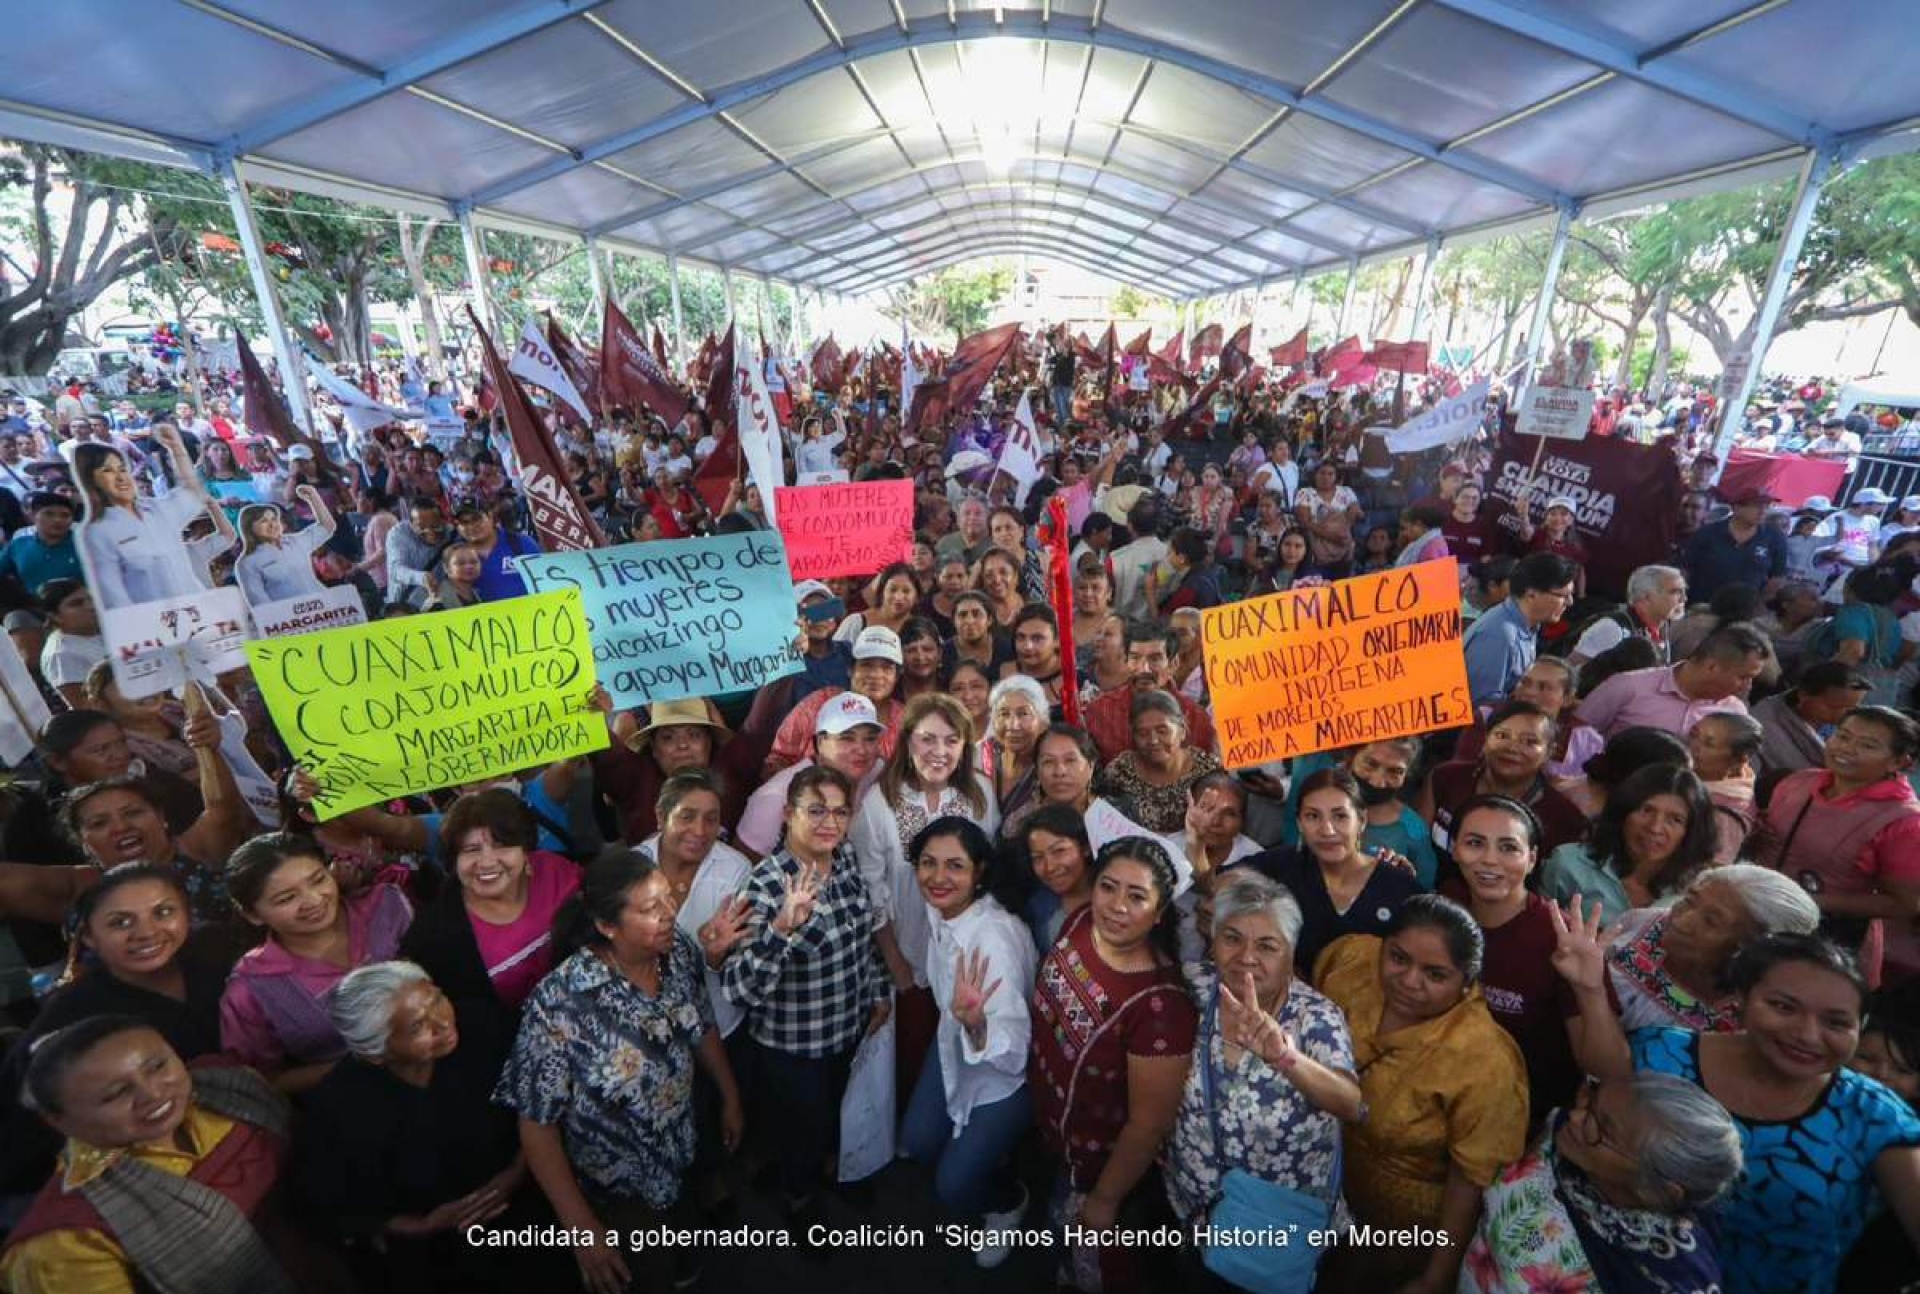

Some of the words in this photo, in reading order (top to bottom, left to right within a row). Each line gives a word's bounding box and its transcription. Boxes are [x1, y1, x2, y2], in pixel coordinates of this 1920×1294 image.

[777, 491, 809, 514] LAS
[820, 486, 899, 510] MUJERES
[1503, 460, 1615, 516] CLAUDIA
[587, 545, 726, 589] tiempo
[736, 535, 782, 567] de
[825, 535, 852, 551] TE
[264, 604, 359, 636] MARGARITA
[605, 576, 744, 628] mujeres
[1204, 571, 1420, 644] CUAXIMALCO
[1209, 637, 1350, 688] COMUNIDAD
[1363, 608, 1460, 657] ORIGINARIA
[614, 662, 707, 699] apoya
[1283, 657, 1406, 704] INDIGENA
[395, 700, 553, 767] MARGARITA
[1224, 717, 1248, 741] DE
[1256, 697, 1345, 734] MORELOS
[1226, 736, 1275, 767] APOYA
[1286, 733, 1300, 752] A
[1316, 696, 1430, 748] MARGARITA
[400, 720, 590, 791] GOBERNADORA
